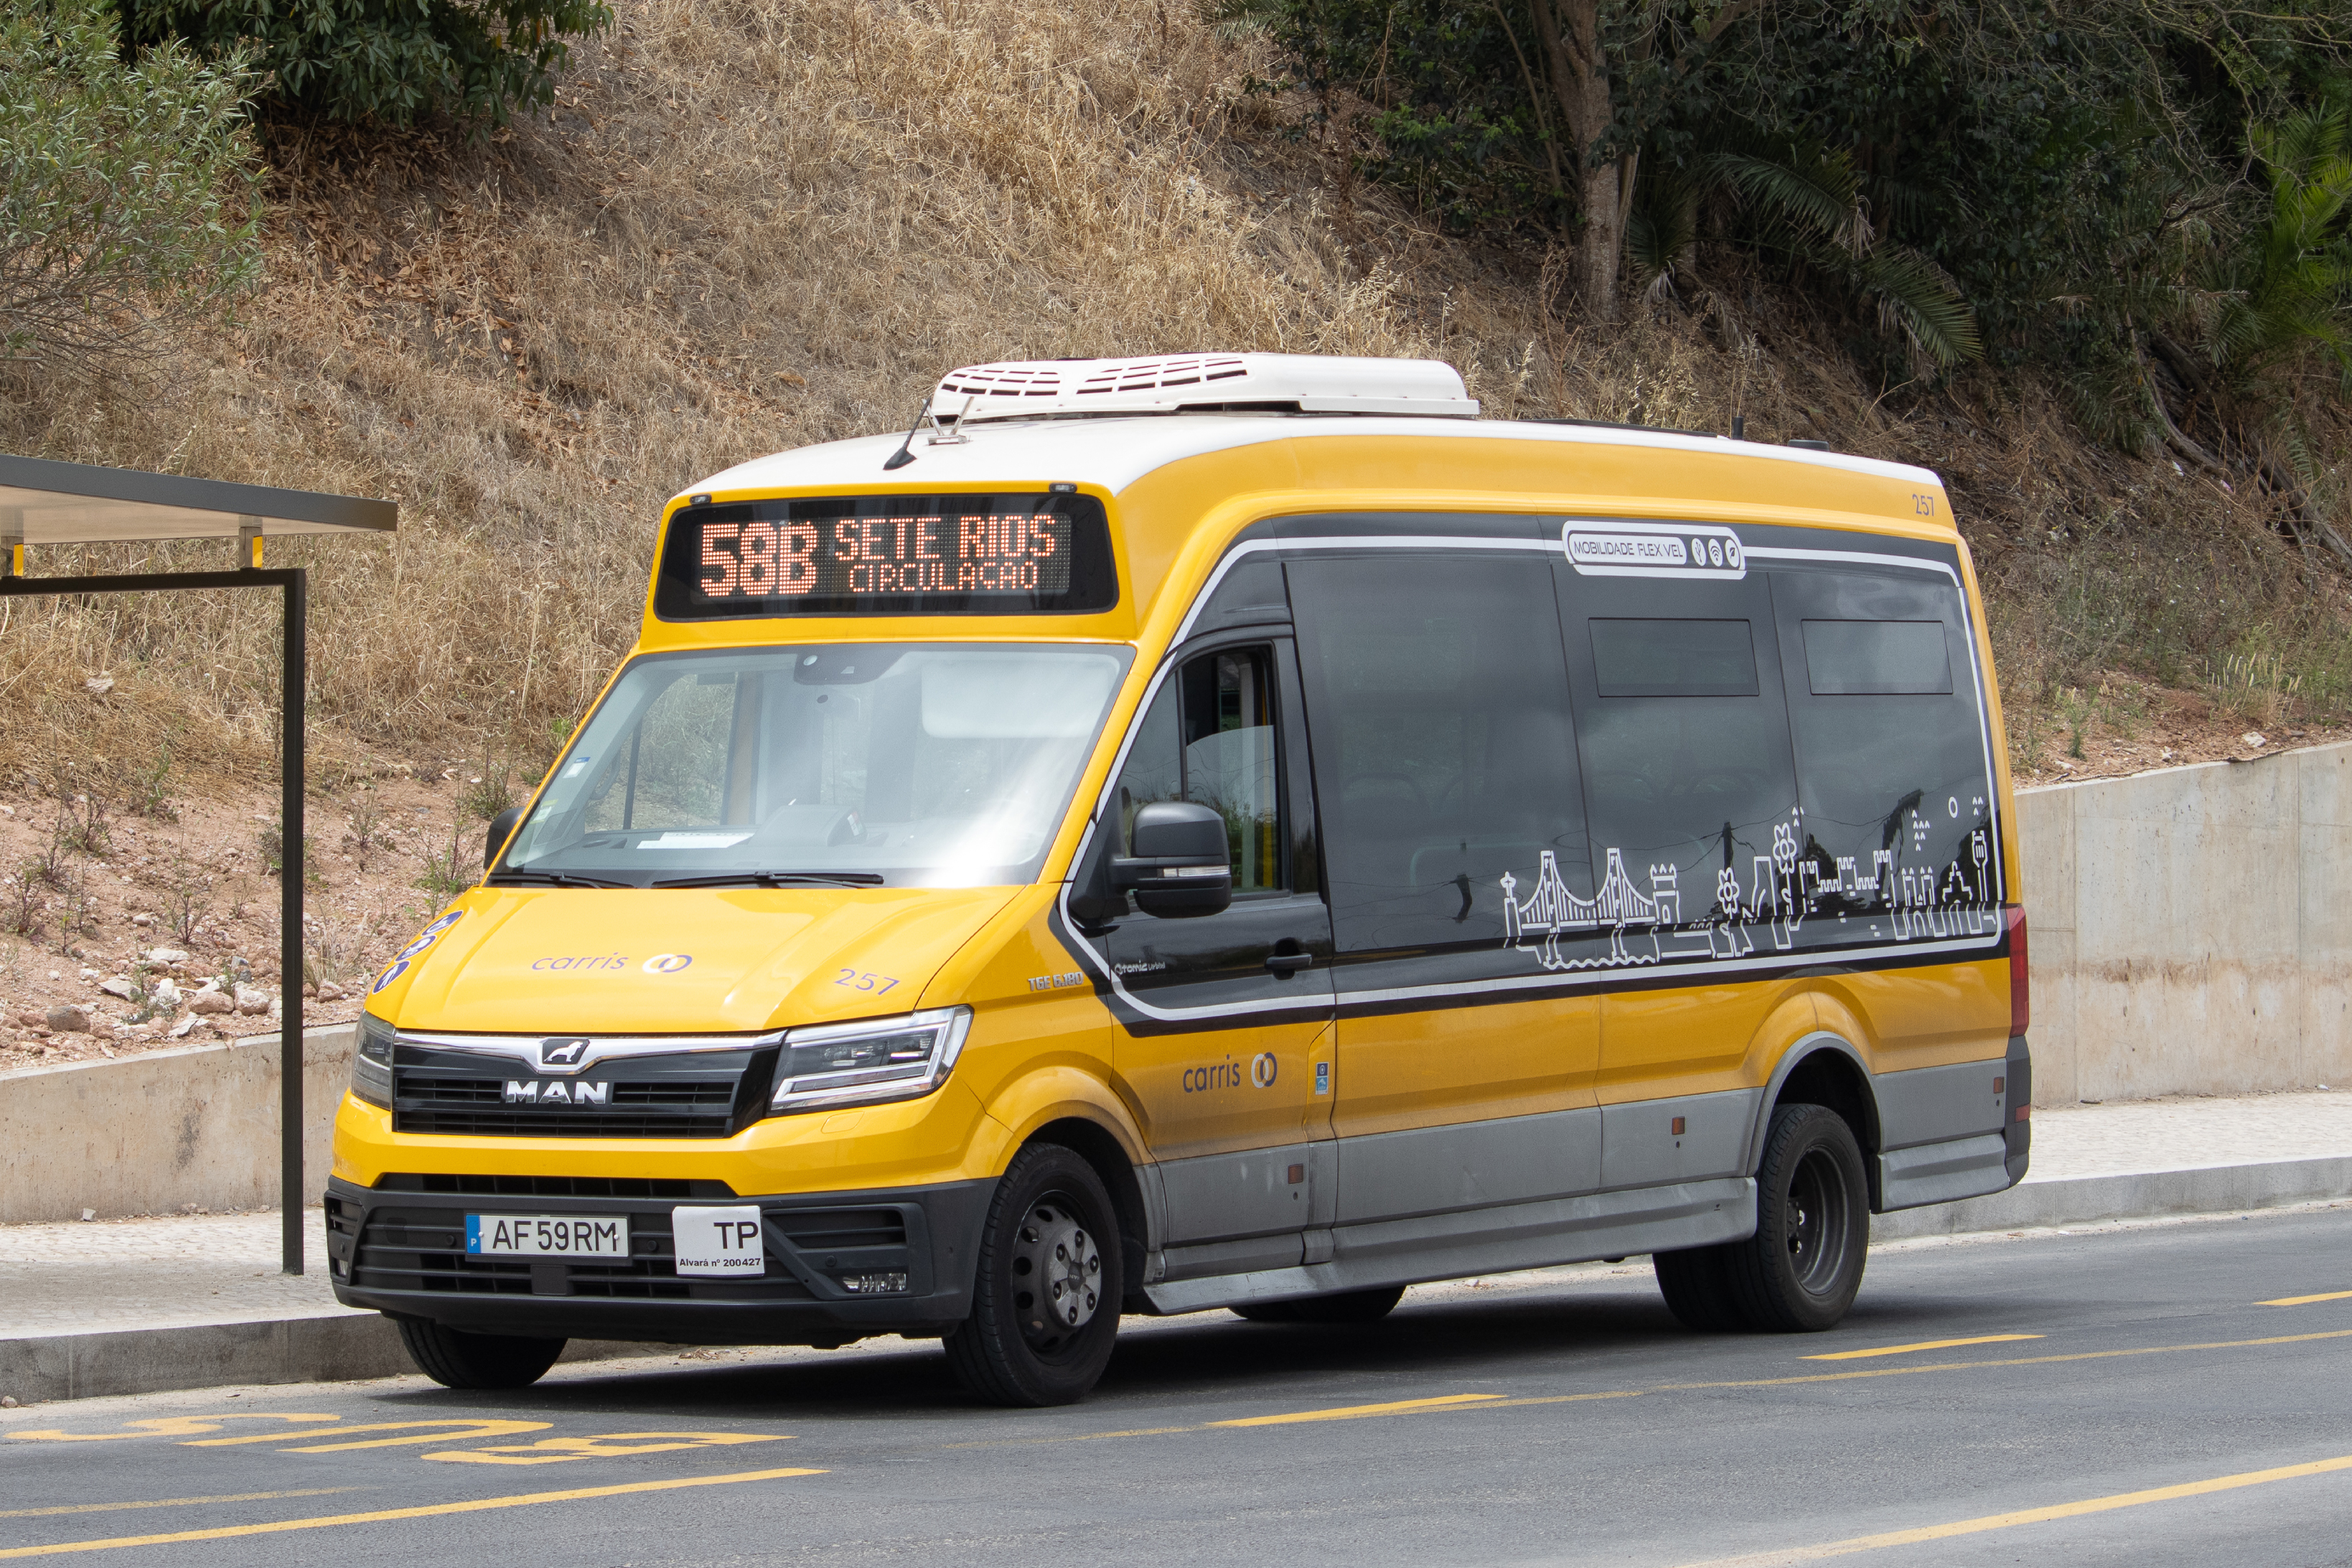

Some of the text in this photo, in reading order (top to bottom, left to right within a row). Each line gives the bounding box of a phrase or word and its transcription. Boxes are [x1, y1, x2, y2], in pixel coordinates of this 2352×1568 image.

[1911, 492, 1934, 517] 257
[835, 515, 1056, 561] SETE RIOS
[1573, 540, 1635, 555] MOBILIDADE
[701, 522, 818, 597] 58B
[531, 952, 629, 972] carris
[833, 967, 901, 997] 257
[1028, 972, 1084, 992] TGE 6.180
[1183, 1053, 1241, 1094] carris
[505, 1080, 608, 1105] MAN
[470, 1237, 477, 1247] P
[713, 1221, 759, 1249] TP
[679, 1258, 709, 1267] Alvará
[723, 1257, 761, 1267] 200427
